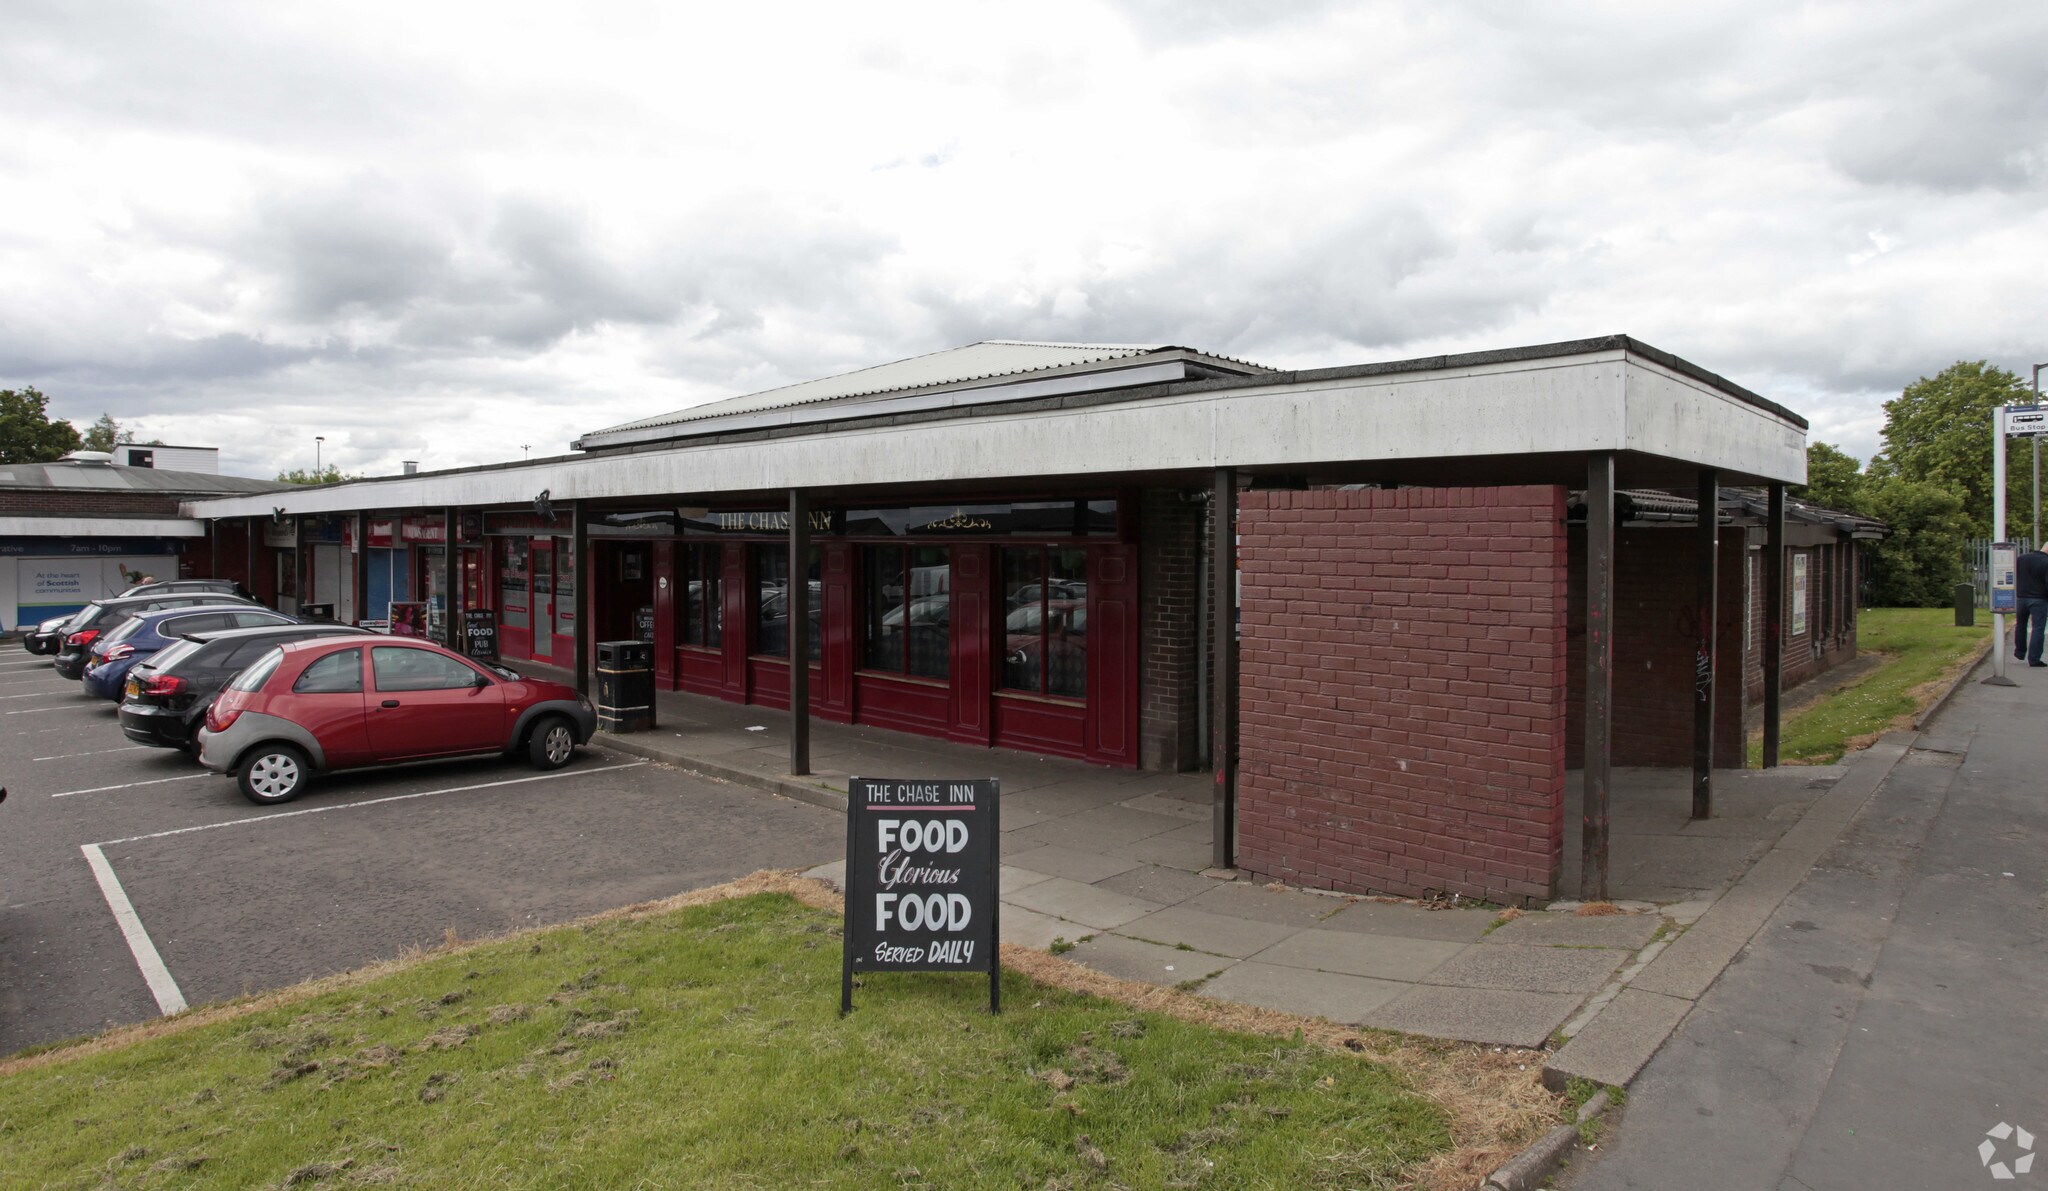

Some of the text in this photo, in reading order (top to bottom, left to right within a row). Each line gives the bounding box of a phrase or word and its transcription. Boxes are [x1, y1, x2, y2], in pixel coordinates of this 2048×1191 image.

[719, 510, 832, 530] THE CHAS NN
[71, 544, 90, 552] 7am
[98, 544, 122, 553] 10pm
[46, 579, 79, 587] Scottish
[467, 627, 494, 637] FOOD
[639, 620, 654, 629] OFFE
[474, 640, 489, 648] PUB
[866, 784, 975, 803] THE CHASE INN
[878, 819, 969, 853] FOOD
[878, 848, 961, 891] Glorious
[875, 893, 972, 932] FOOD
[927, 940, 975, 964] DAILY
